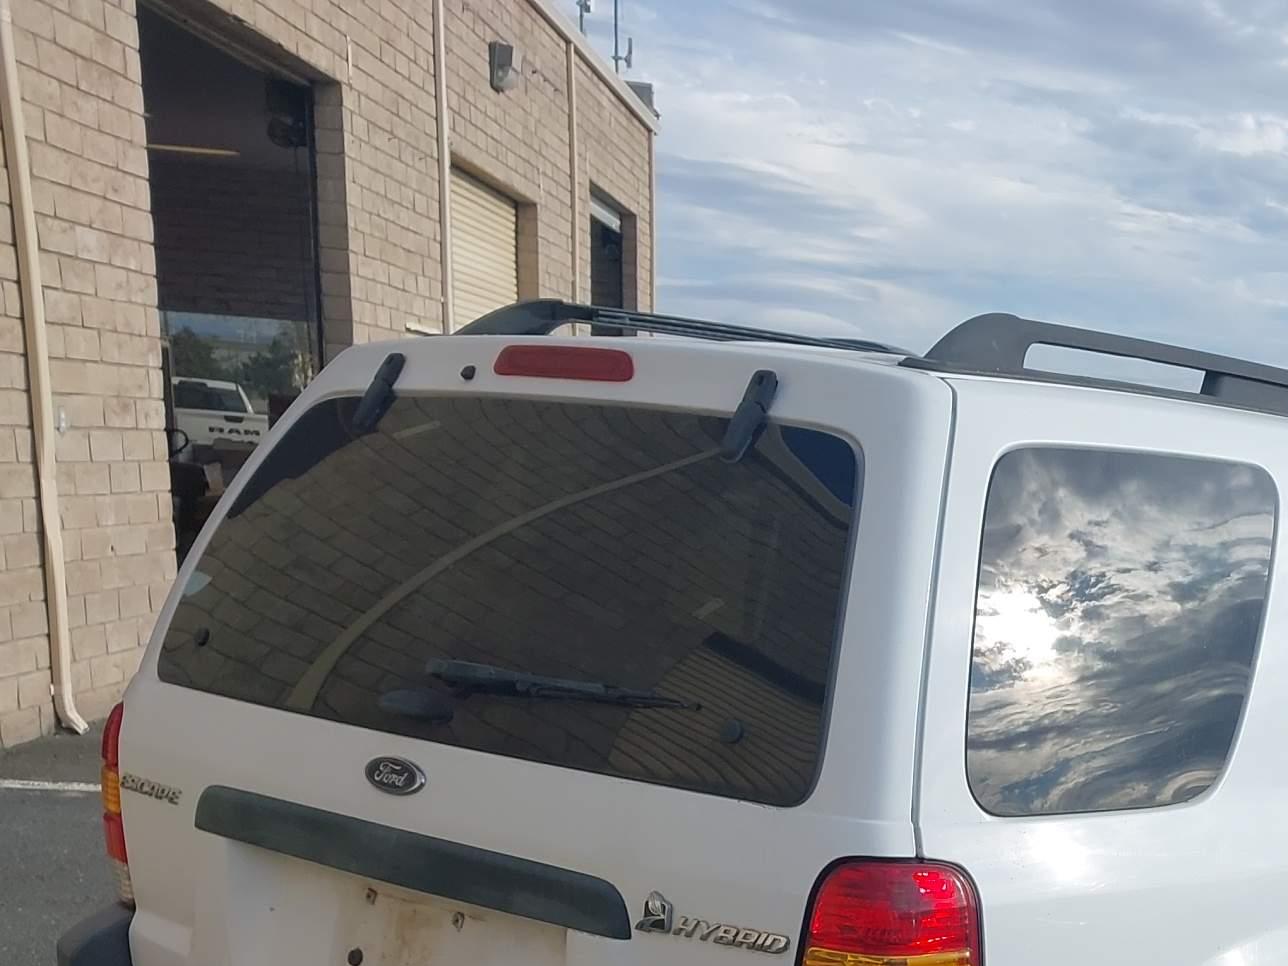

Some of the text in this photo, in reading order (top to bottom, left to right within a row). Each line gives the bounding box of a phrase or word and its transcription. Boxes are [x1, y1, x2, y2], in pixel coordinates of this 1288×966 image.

[208, 426, 260, 436] RAM
[120, 774, 183, 806] ESCAPE
[672, 915, 791, 954] HYBRID
